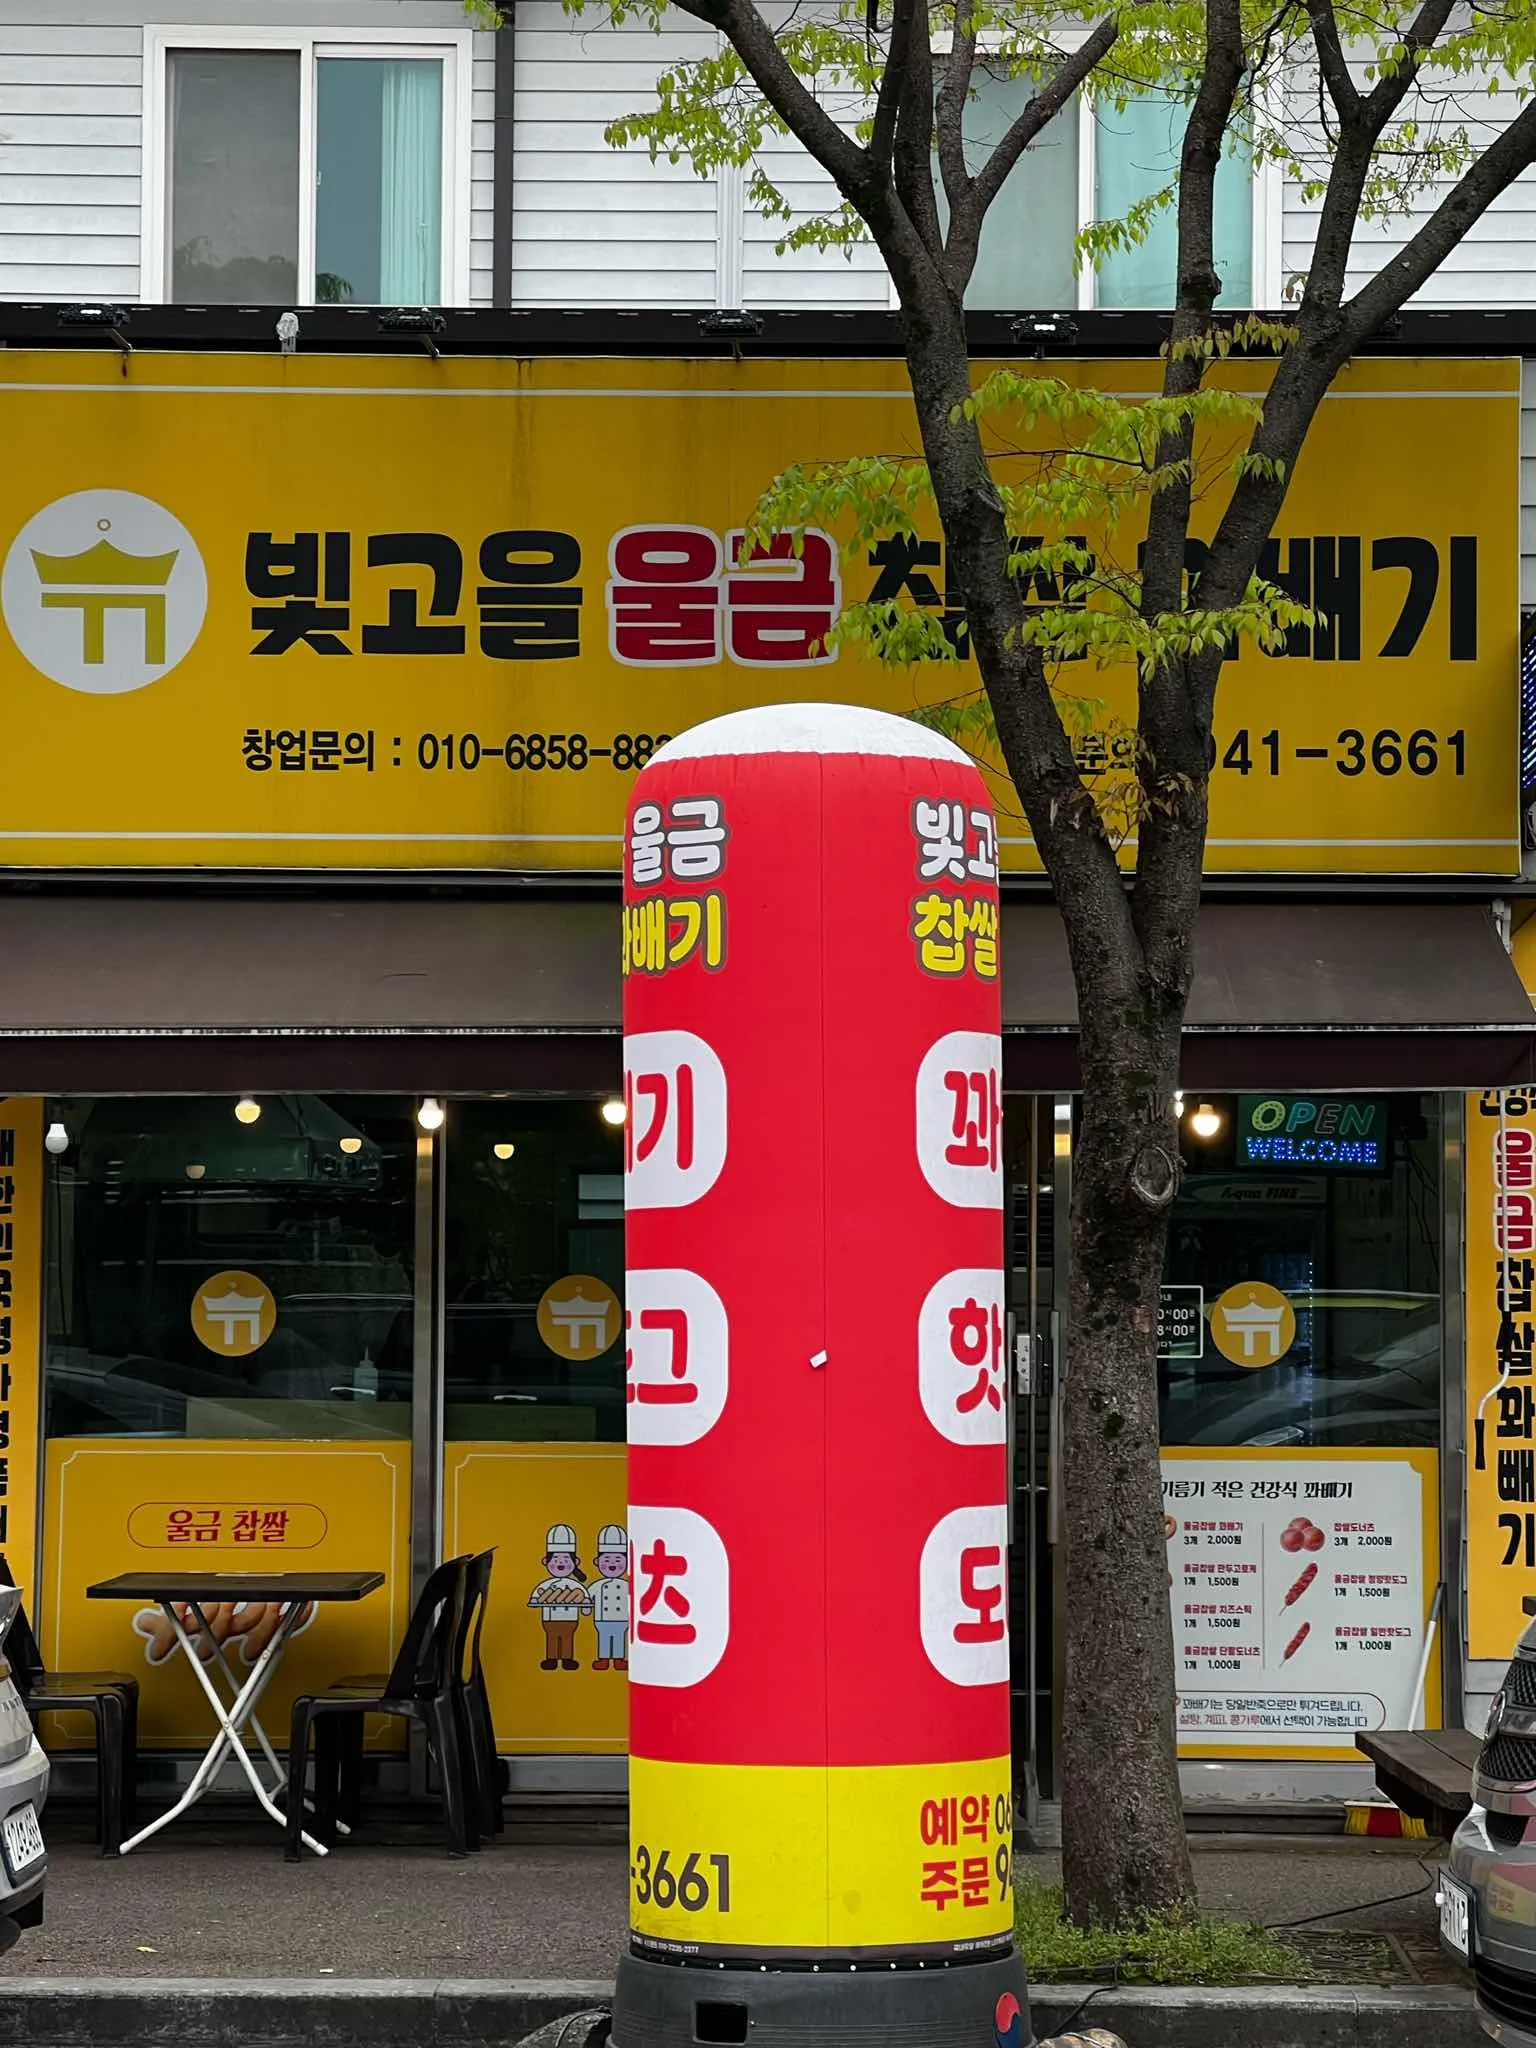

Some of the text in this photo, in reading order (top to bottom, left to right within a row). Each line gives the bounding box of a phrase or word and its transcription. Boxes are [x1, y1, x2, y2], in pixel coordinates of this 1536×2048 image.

[245, 530, 583, 661] 빛고을
[607, 524, 842, 667] 울금
[243, 729, 376, 772] 창업문의
[416, 733, 673, 771] 010-6858-88
[630, 799, 727, 883] 울금
[916, 801, 1000, 890] 빛고
[914, 894, 998, 978] 찹쌀
[625, 1063, 695, 1174] 기
[1246, 1136, 1378, 1165] WELCOME
[1251, 1100, 1376, 1136] OPEN
[626, 1309, 698, 1405] 그
[1211, 1480, 1244, 1498] 적은
[1250, 1480, 1298, 1499] 건강식
[1303, 1481, 1353, 1499] 꽈배기
[166, 1509, 290, 1543] 울금 찹쌀
[628, 1538, 697, 1646] 츠
[919, 1794, 990, 1846] 예약
[920, 1856, 990, 1912] 주문
